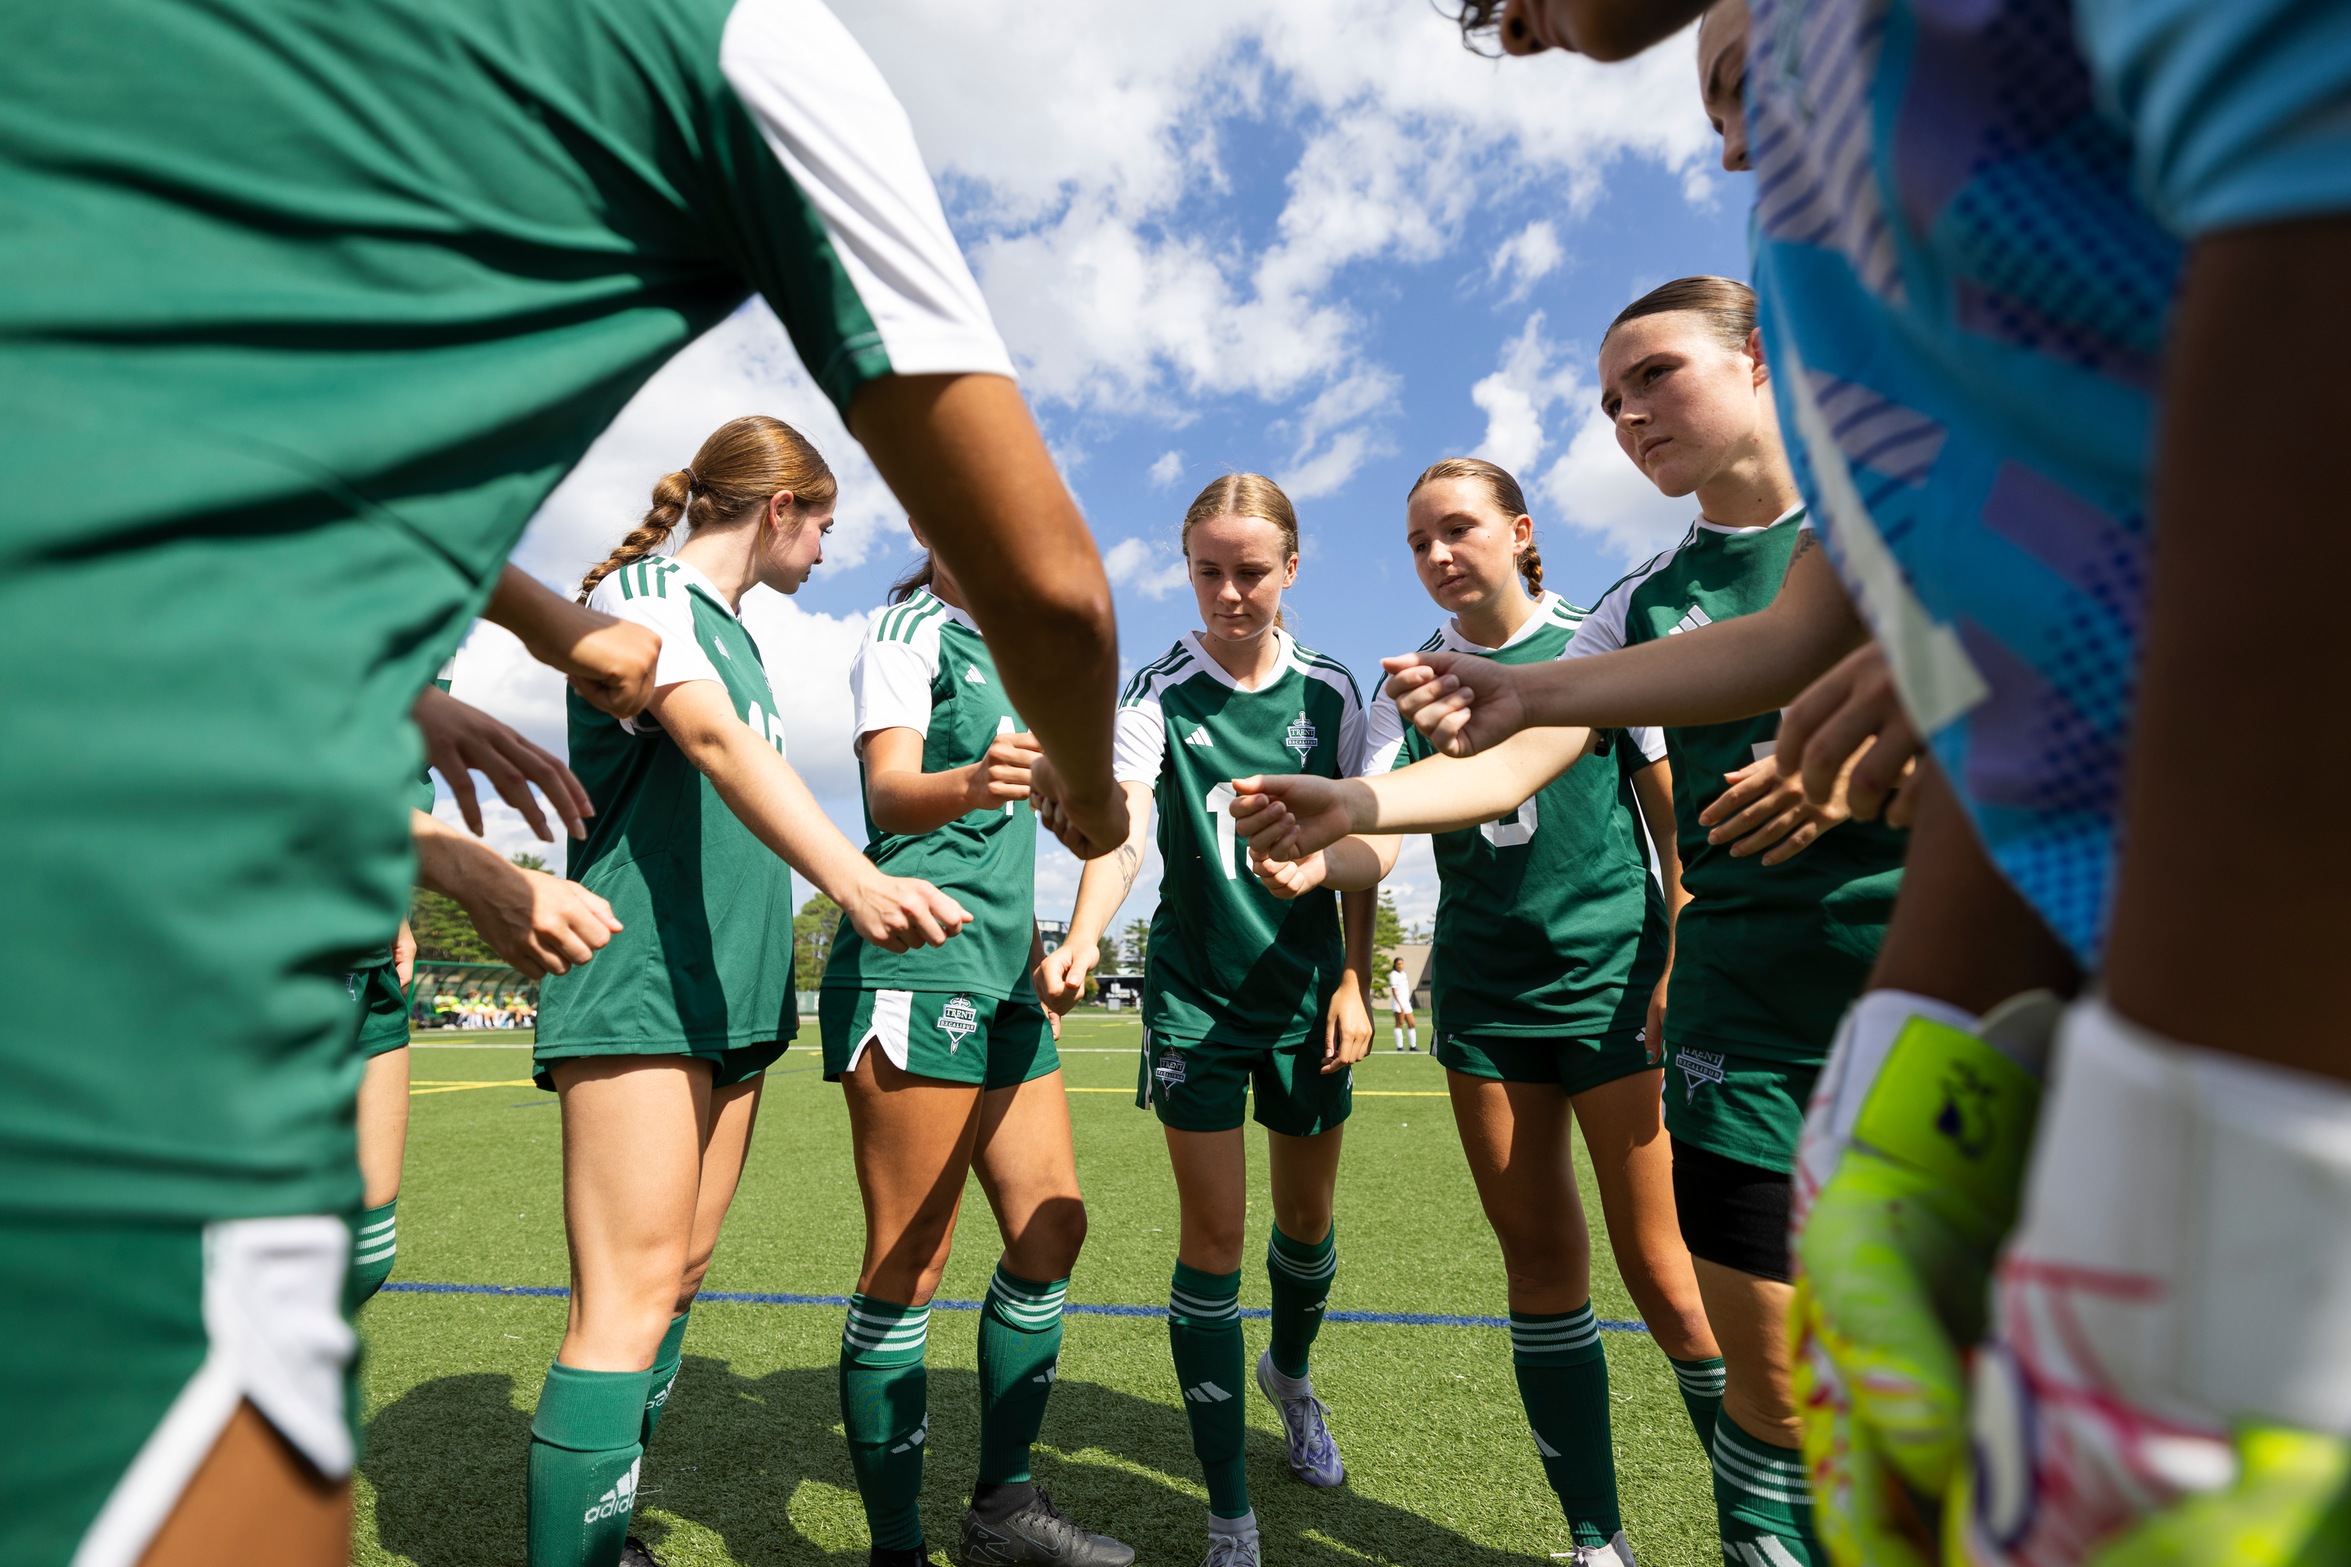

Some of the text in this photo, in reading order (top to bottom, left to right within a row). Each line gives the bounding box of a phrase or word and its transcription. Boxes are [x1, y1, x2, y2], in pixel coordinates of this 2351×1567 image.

[946, 1008, 974, 1020] TRENT
[1162, 1061, 1183, 1071] TRENT
[1678, 1058, 1720, 1078] EXCALIBUR
[584, 1490, 637, 1523] adid
